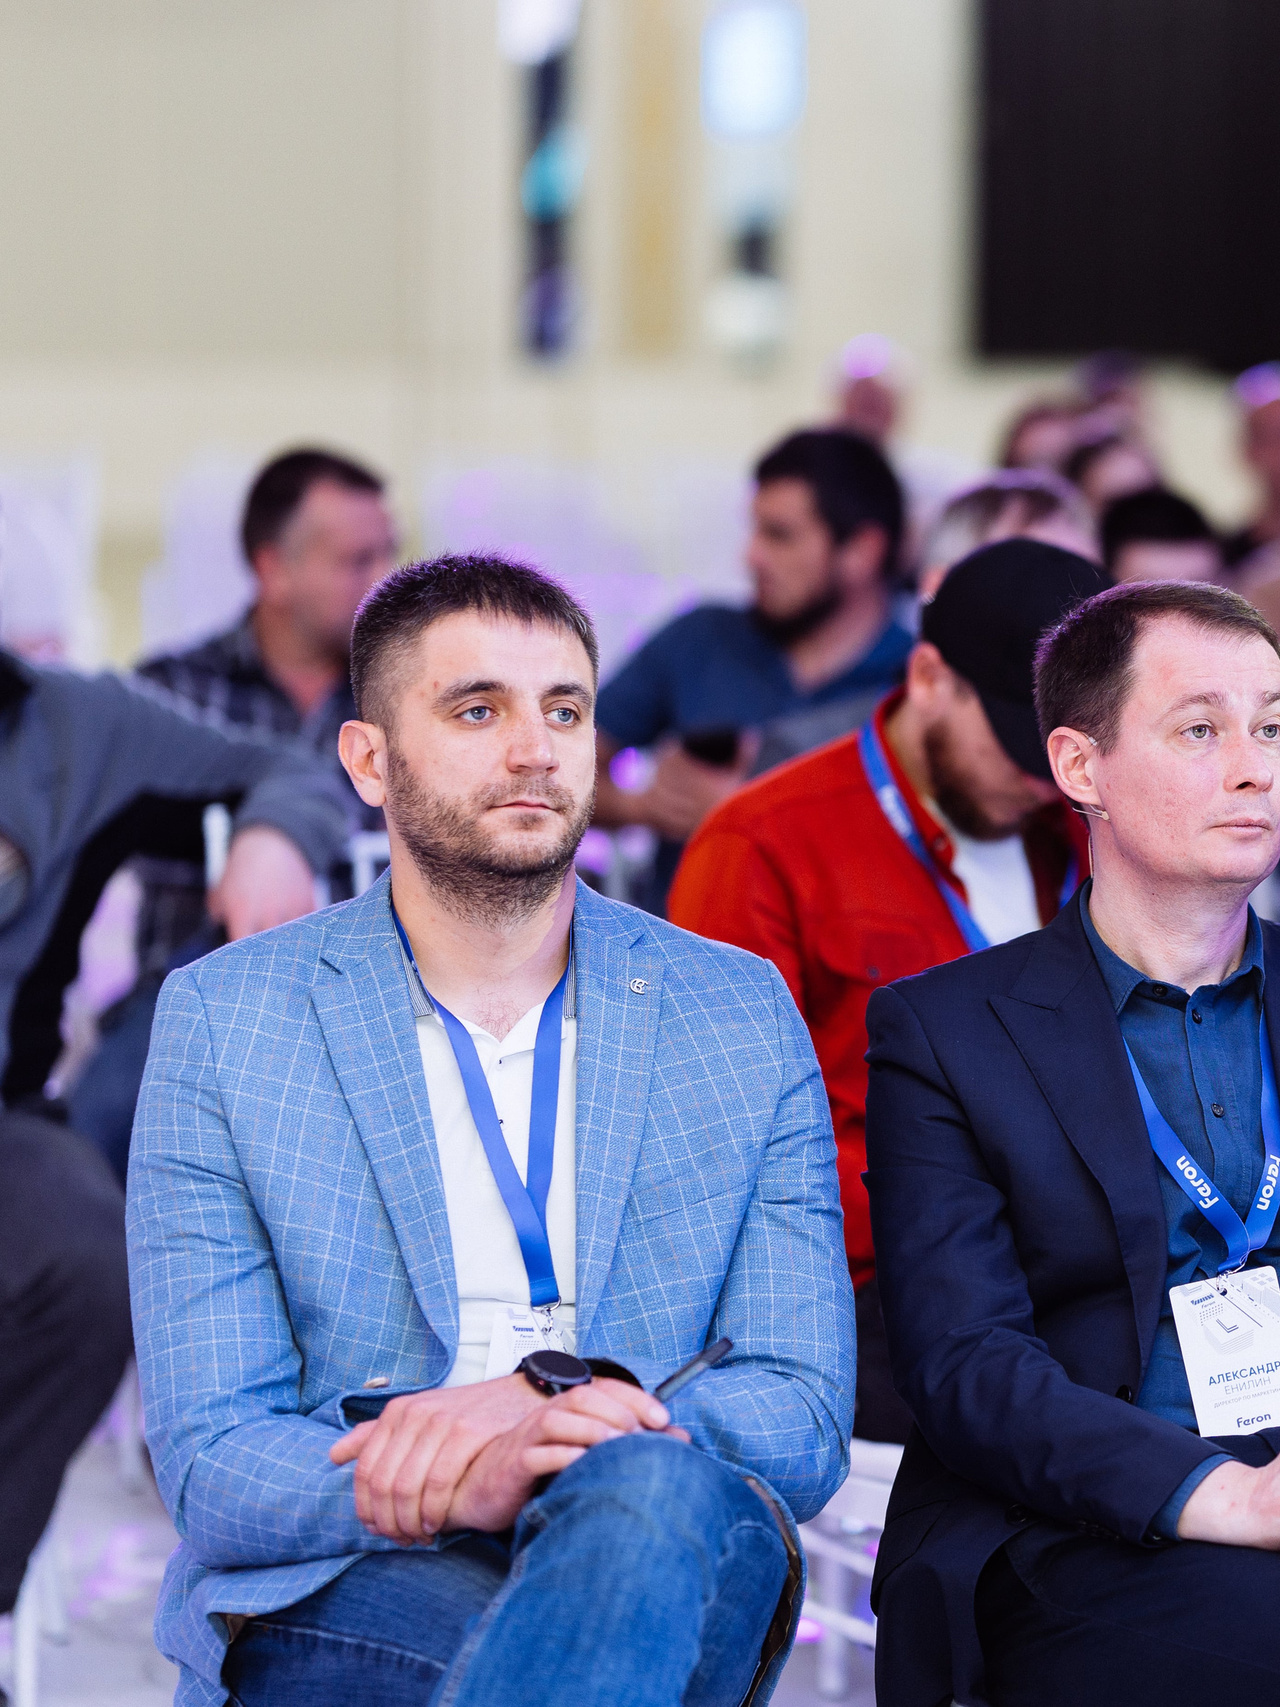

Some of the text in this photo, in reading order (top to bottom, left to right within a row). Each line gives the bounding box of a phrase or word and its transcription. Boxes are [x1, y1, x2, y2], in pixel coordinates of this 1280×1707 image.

[1176, 1155, 1219, 1209] Feron
[1224, 1376, 1272, 1395] ЕНИЛИН
[1236, 1413, 1272, 1428] Feron
